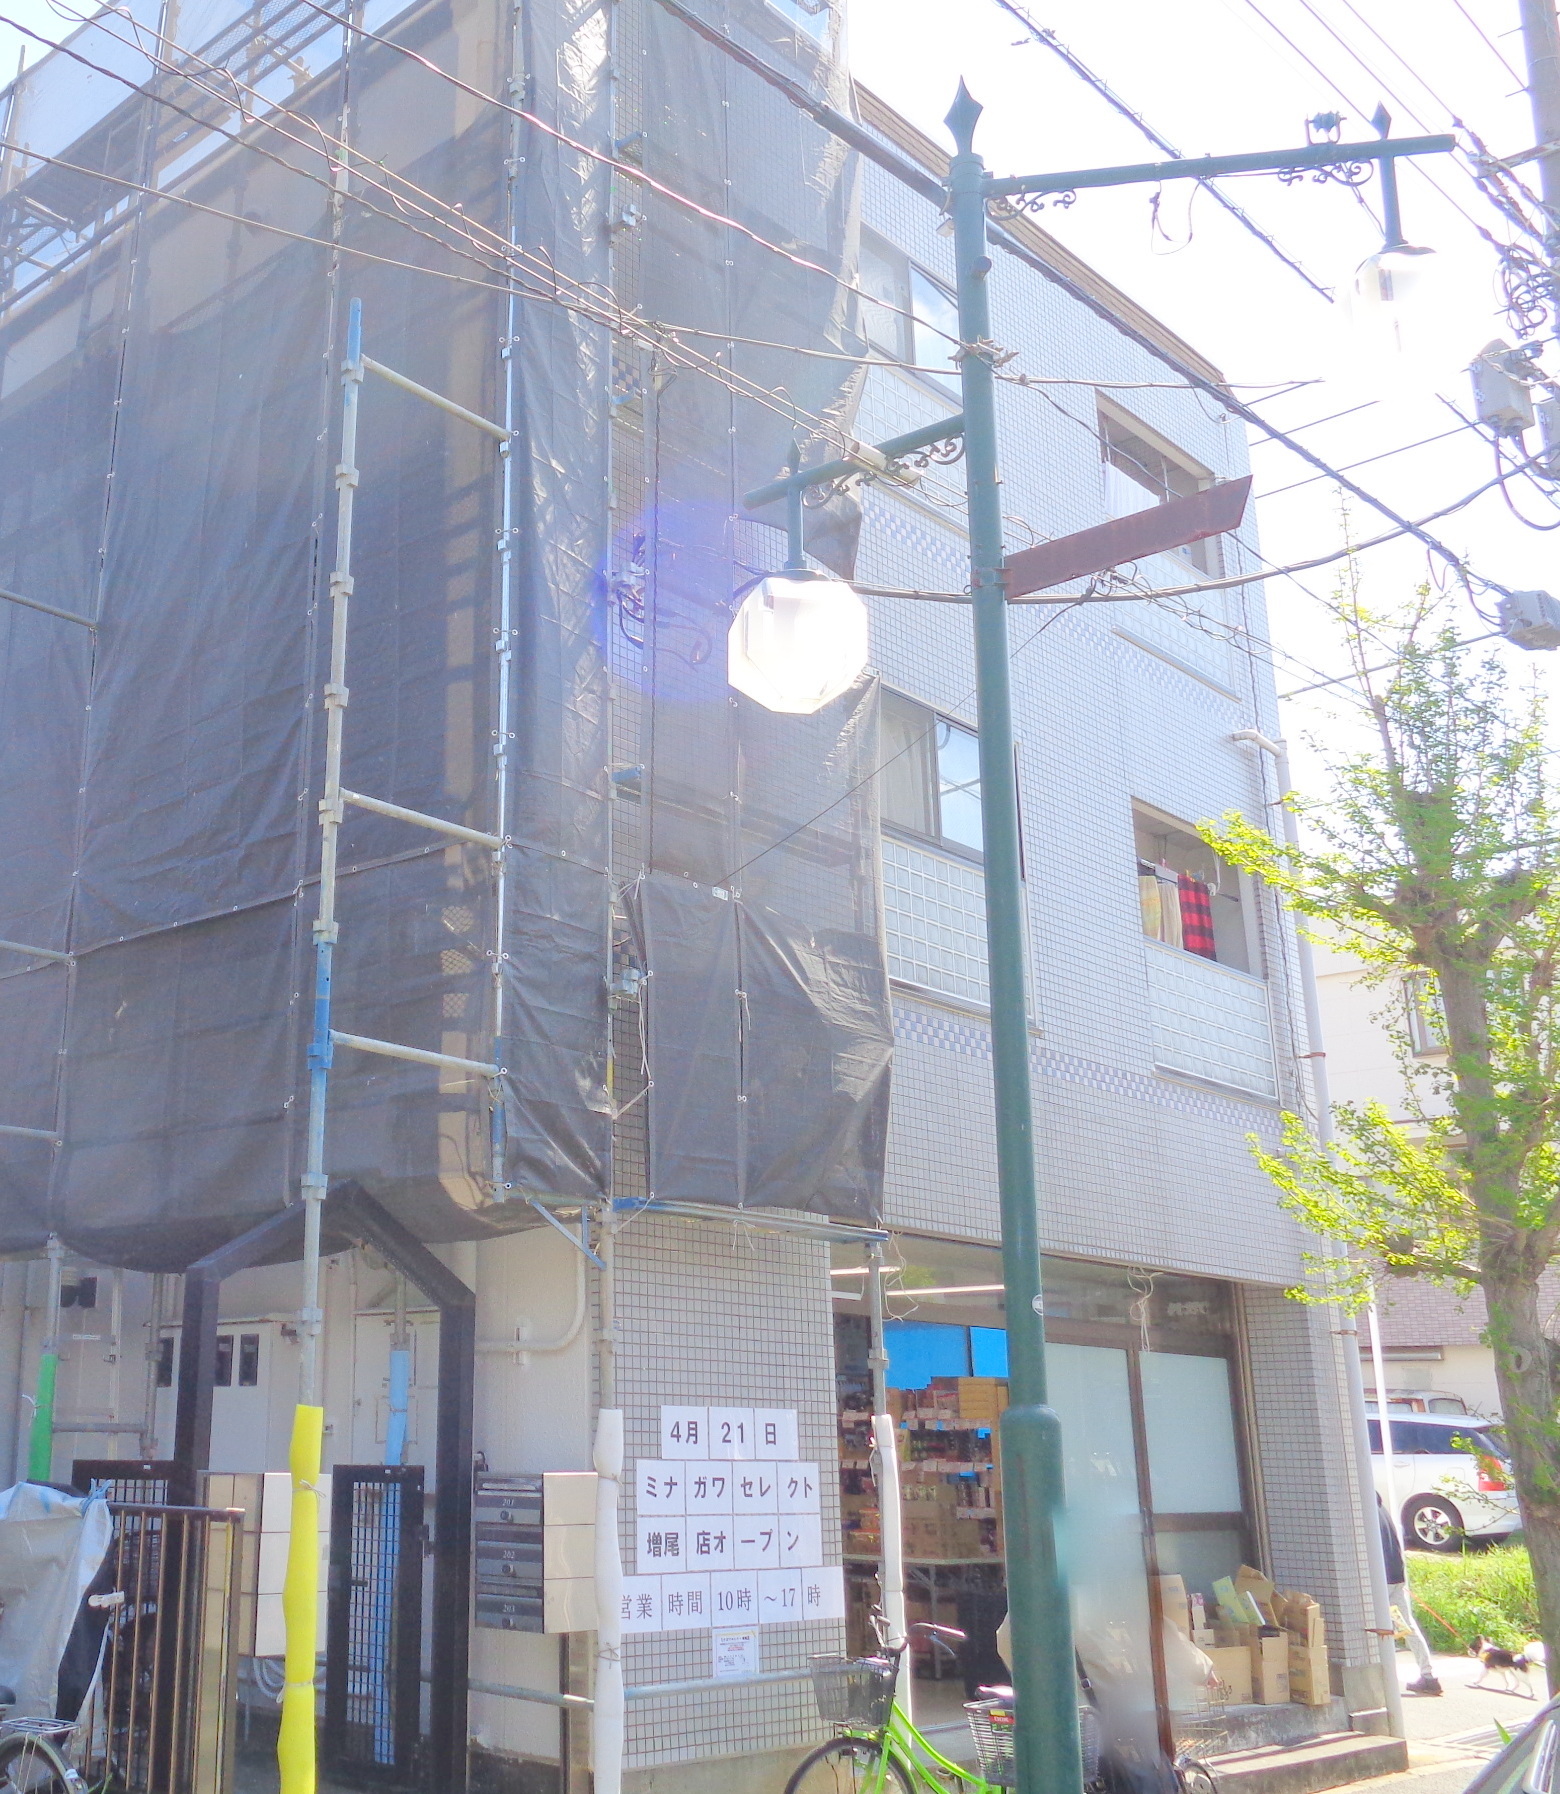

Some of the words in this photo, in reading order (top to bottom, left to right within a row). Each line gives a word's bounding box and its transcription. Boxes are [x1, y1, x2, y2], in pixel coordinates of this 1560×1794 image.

[669, 1420, 777, 1446] 4月21日
[645, 1475, 813, 1499] ミナガワセレクト
[646, 1529, 799, 1558] 増尾店オープン
